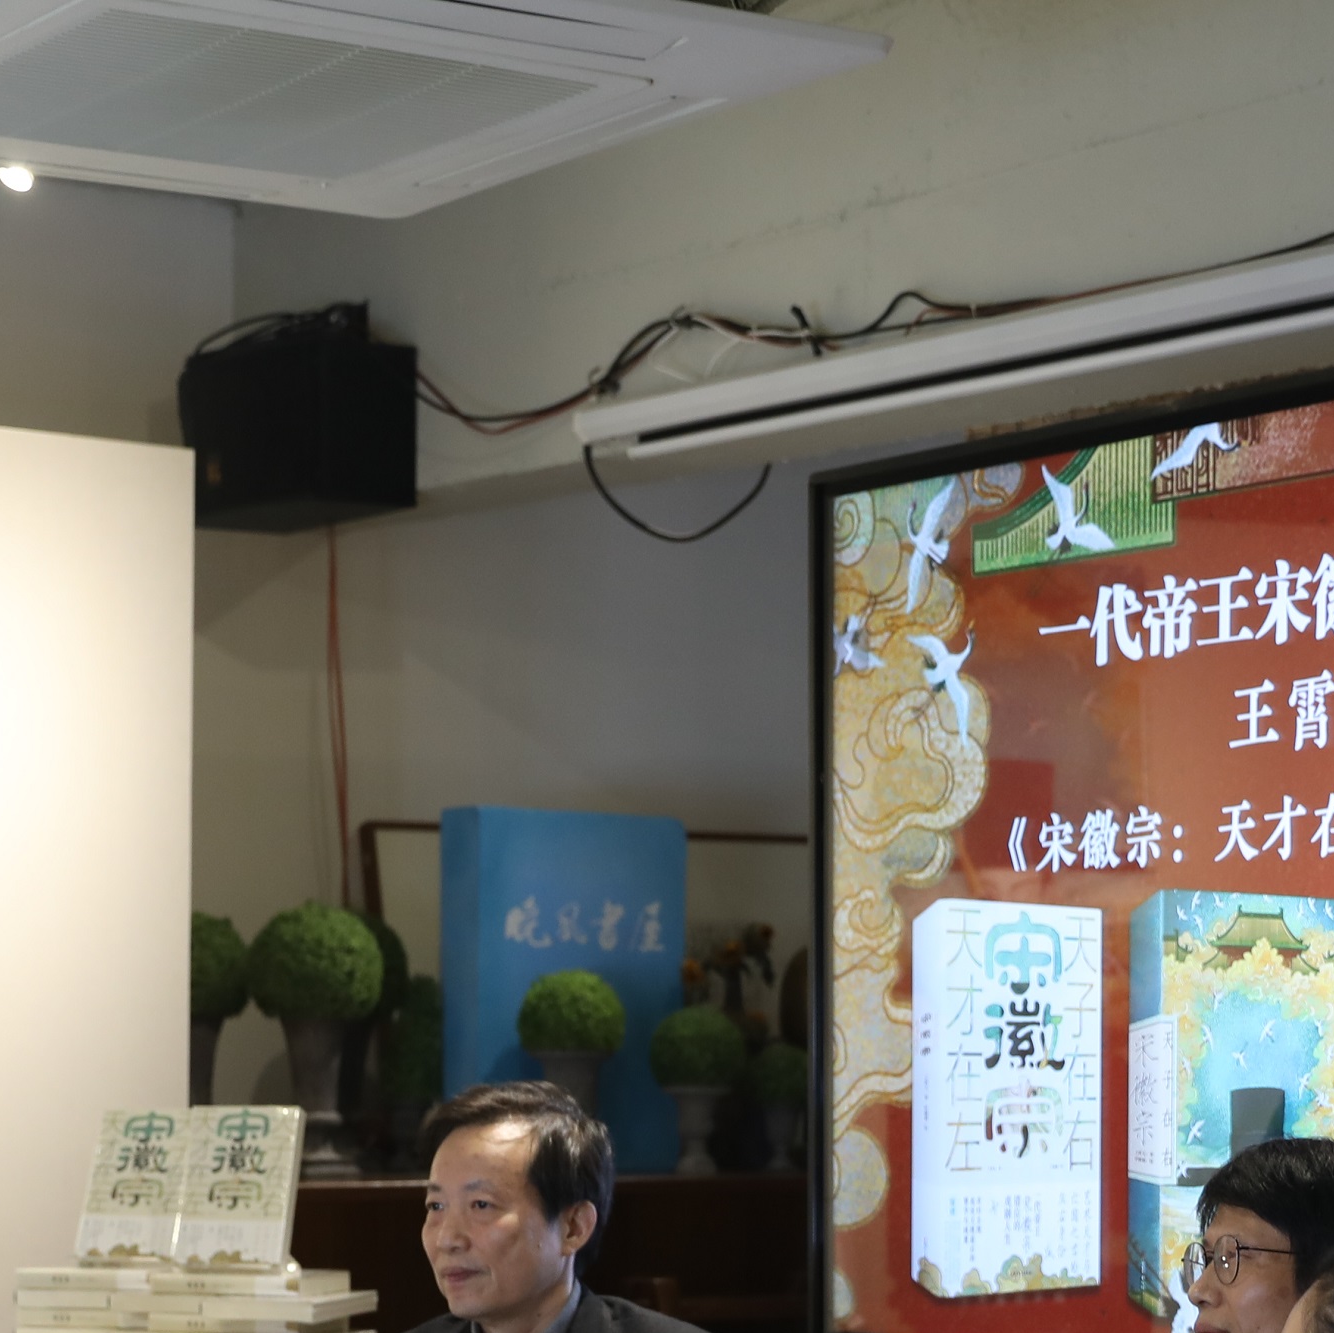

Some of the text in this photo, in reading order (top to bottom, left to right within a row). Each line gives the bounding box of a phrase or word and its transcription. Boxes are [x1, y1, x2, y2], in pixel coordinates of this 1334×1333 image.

[111, 1111, 176, 1208] 宋徽宗
[208, 1109, 271, 1210] 宋徽宗
[945, 907, 983, 1173] 天才在左
[983, 909, 1066, 1160] 宋徽宗
[1063, 915, 1098, 1173] 天子在右
